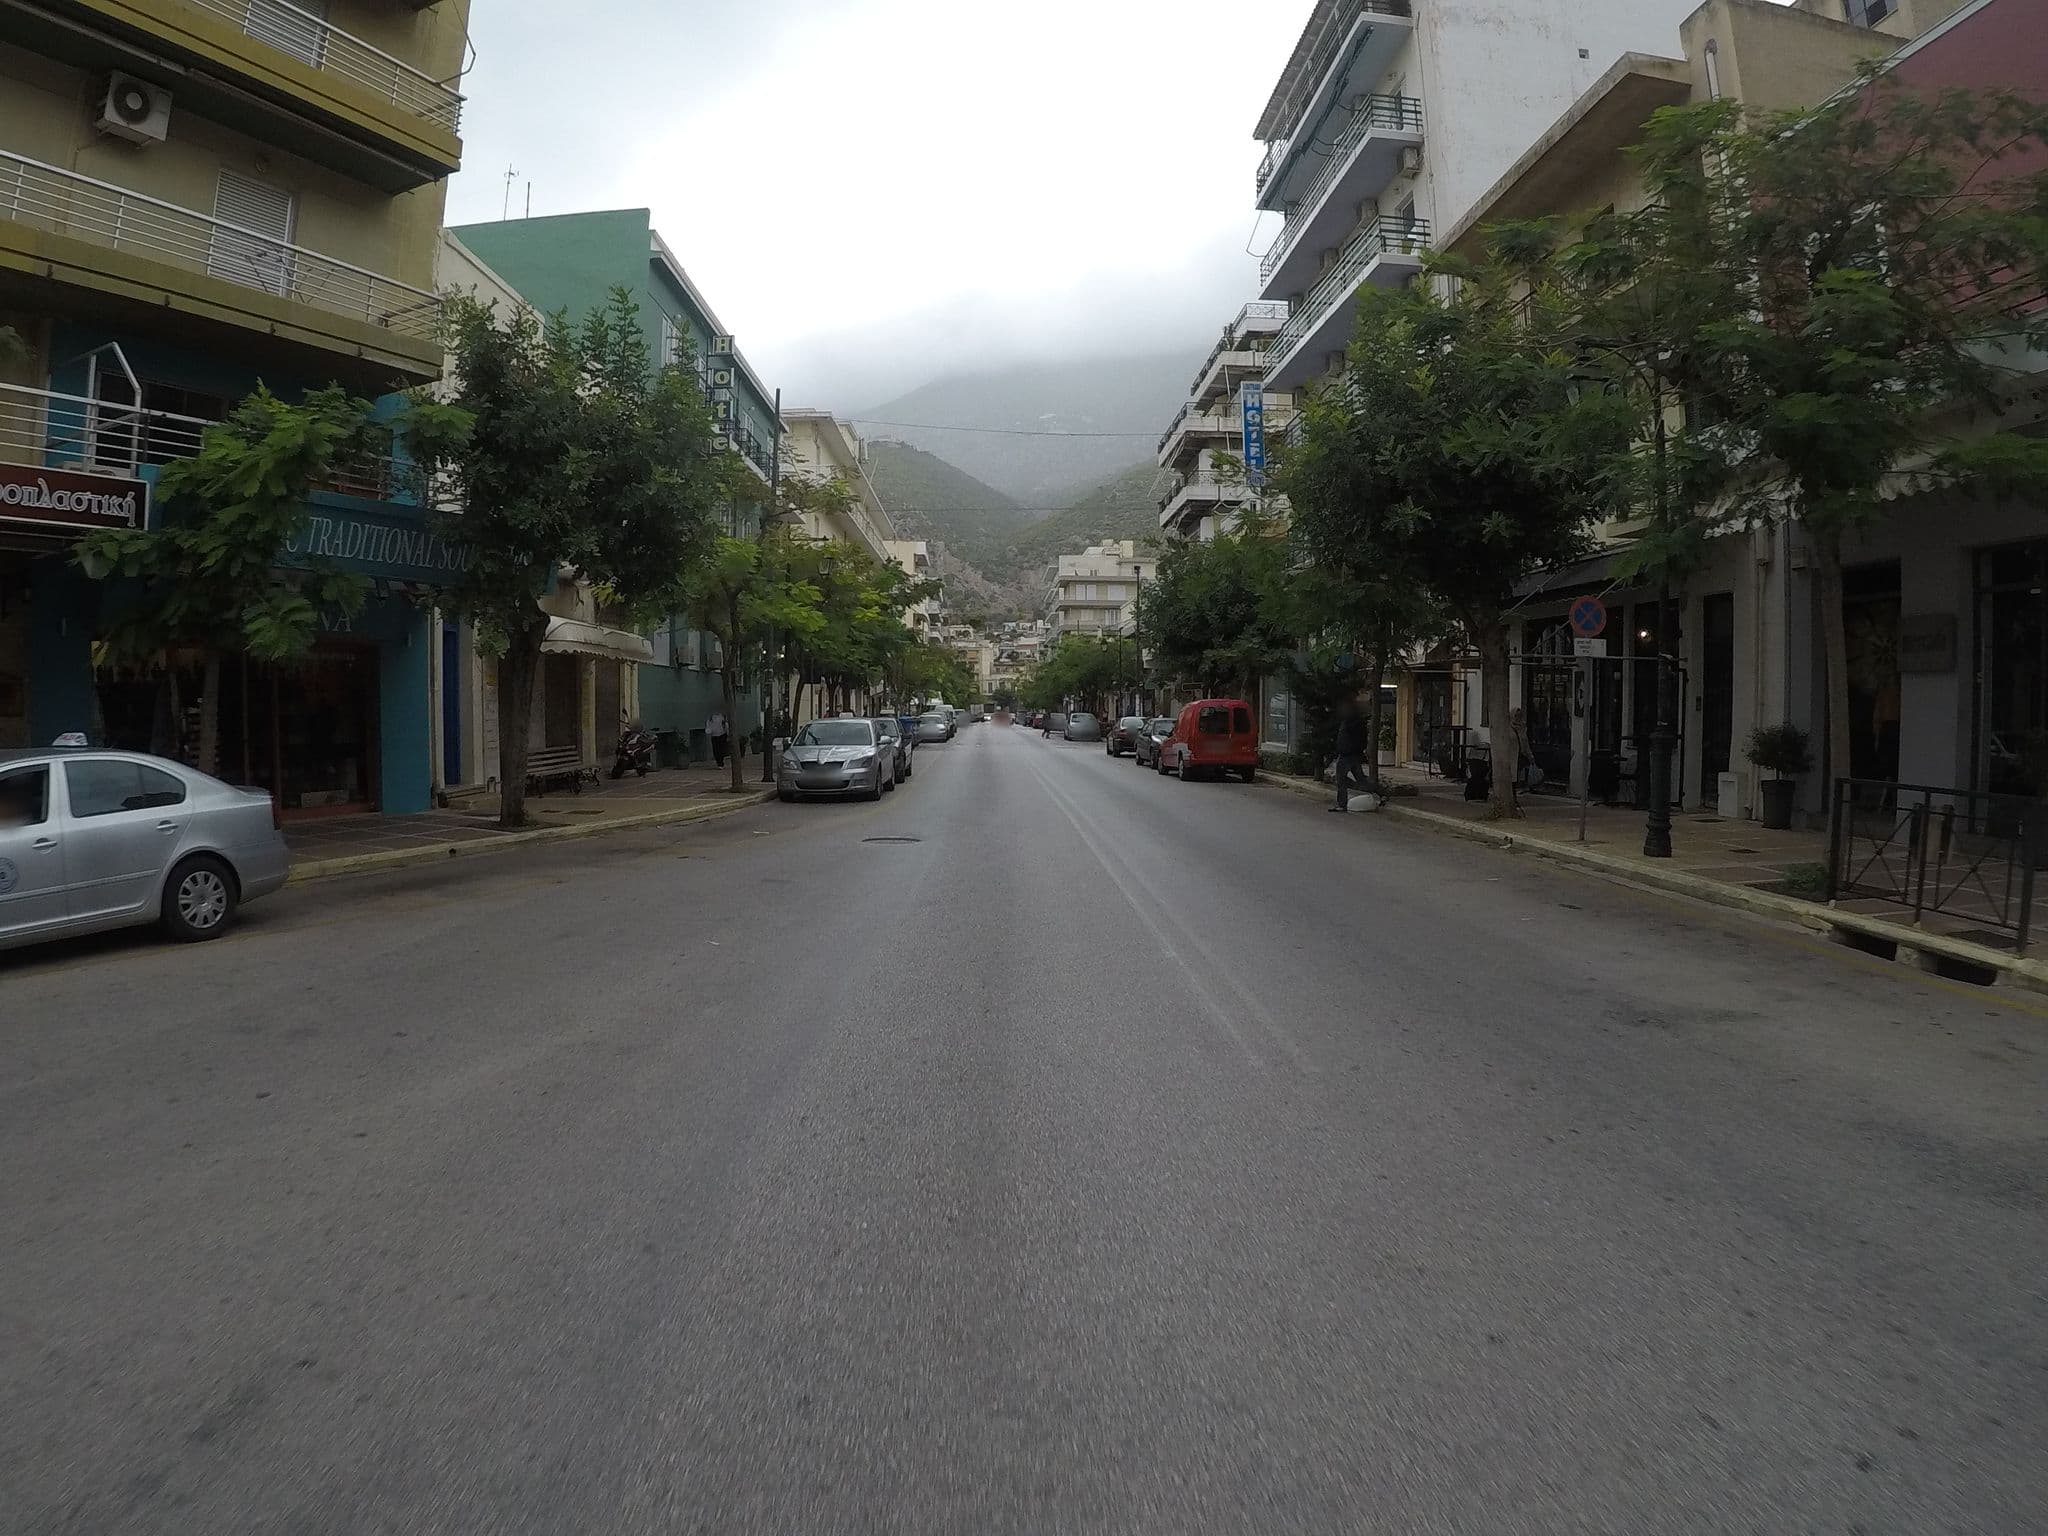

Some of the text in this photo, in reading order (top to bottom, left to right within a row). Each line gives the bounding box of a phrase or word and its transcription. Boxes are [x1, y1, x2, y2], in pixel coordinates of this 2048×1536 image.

[713, 338, 732, 450] Hote
[1246, 394, 1261, 472] HOTEL
[0, 478, 136, 527] οπλαστική
[307, 516, 434, 568] TRADITIONAL
